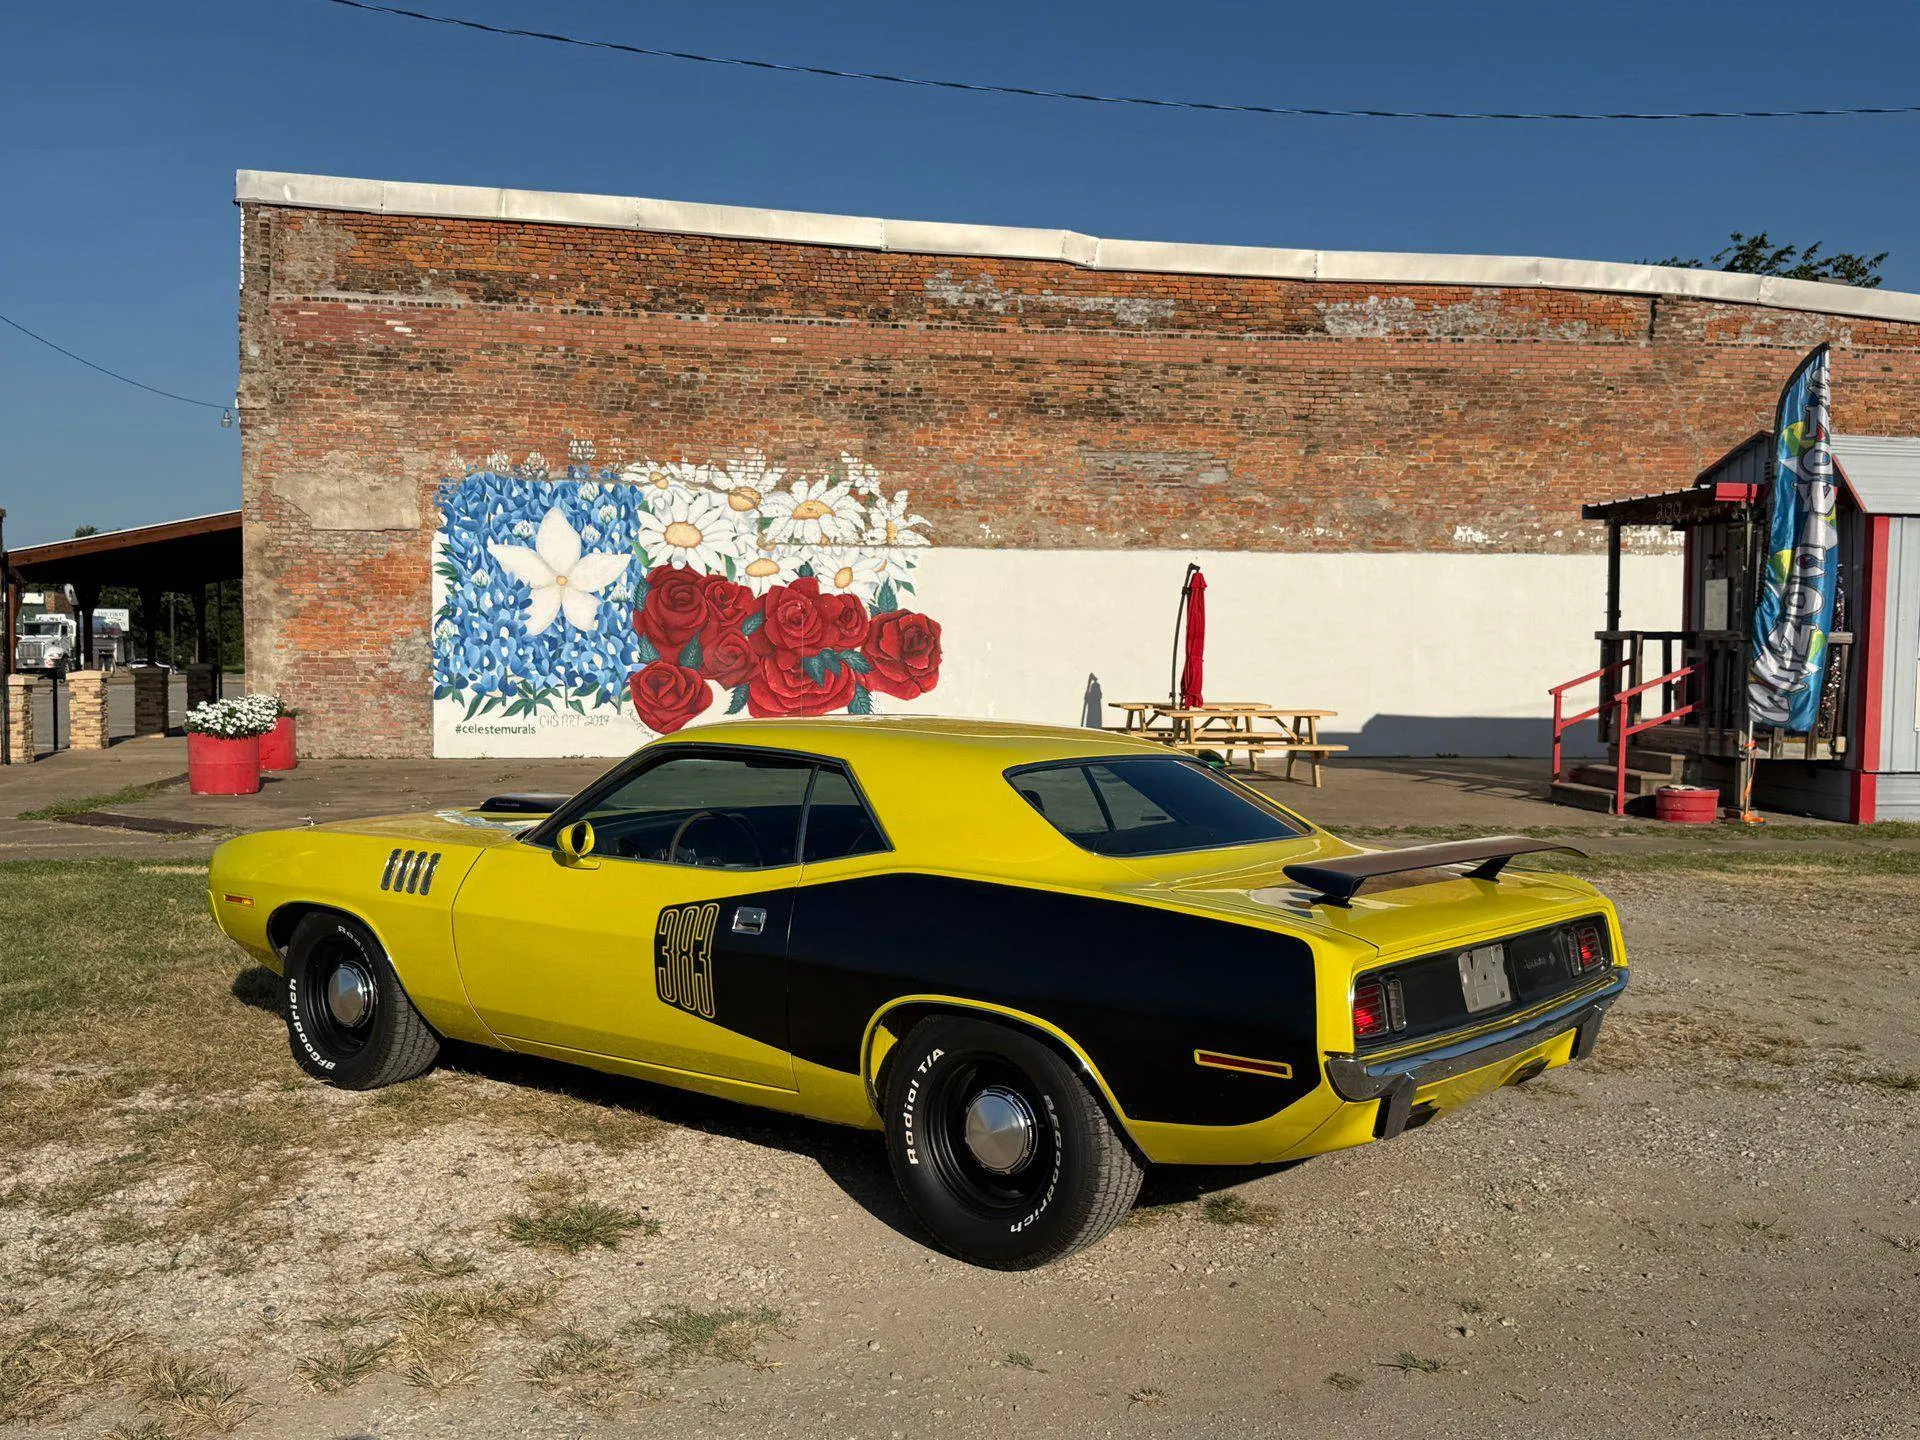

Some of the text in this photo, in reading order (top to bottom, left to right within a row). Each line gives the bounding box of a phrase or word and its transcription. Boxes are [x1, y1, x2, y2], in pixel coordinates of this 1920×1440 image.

[455, 723, 536, 735] #celestemurals
[658, 902, 720, 1019] 383
[290, 978, 336, 1071] BFGoodrich
[903, 1048, 945, 1165] Radial T/A
